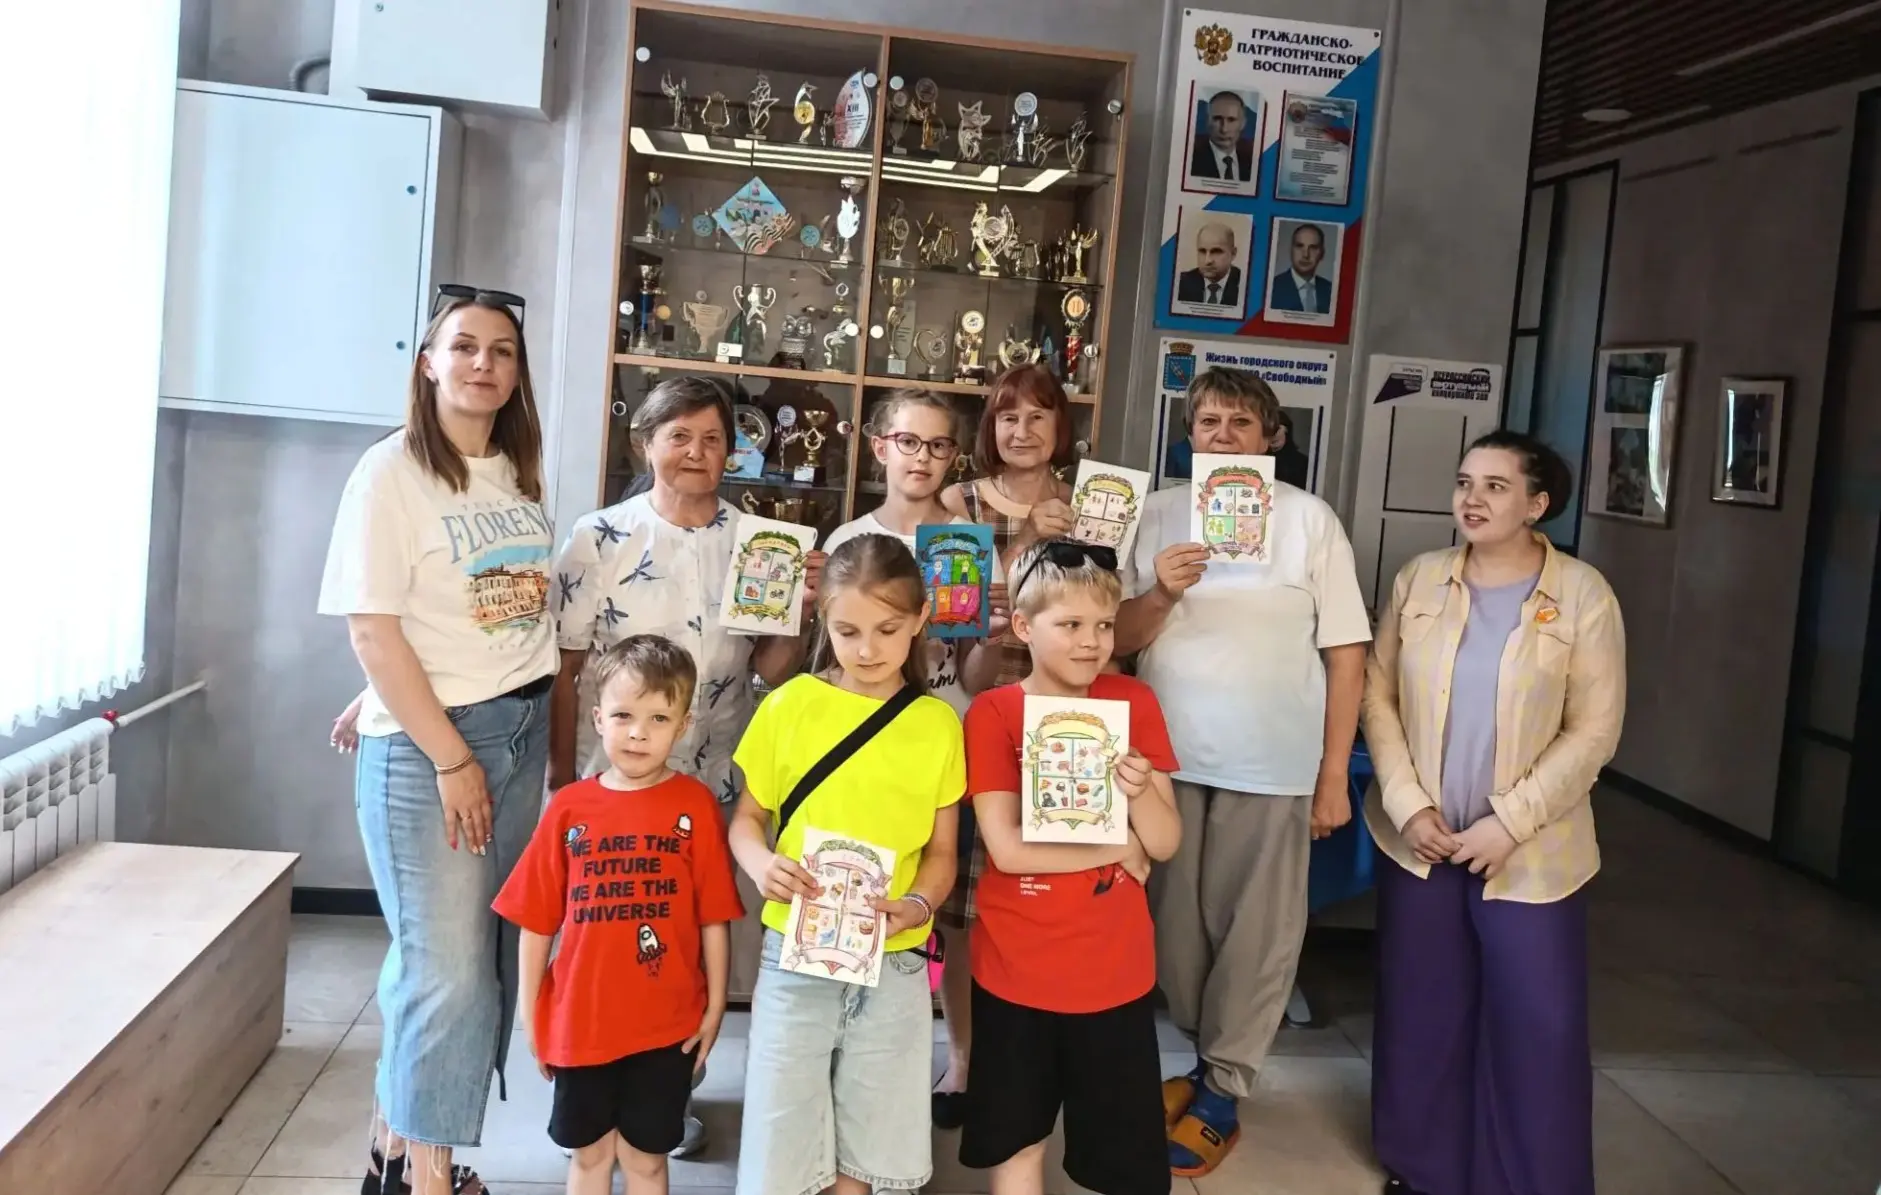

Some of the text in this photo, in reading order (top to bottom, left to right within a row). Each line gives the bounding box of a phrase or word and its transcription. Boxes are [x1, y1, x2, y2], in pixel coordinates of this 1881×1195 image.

[1251, 28, 1353, 49] ГРАЖДАНСКО-
[1237, 42, 1365, 66] ПАТРИОТИЧЕСКОЕ
[1252, 60, 1347, 80] ВОСПИТАНИЕ
[1205, 352, 1328, 372] Жизнь городского округа
[571, 835, 681, 858] WE ARE THE
[583, 857, 661, 878] FUTURE
[594, 881, 635, 898] ARE
[641, 878, 678, 896] THE
[573, 902, 670, 924] UNIVERSE
